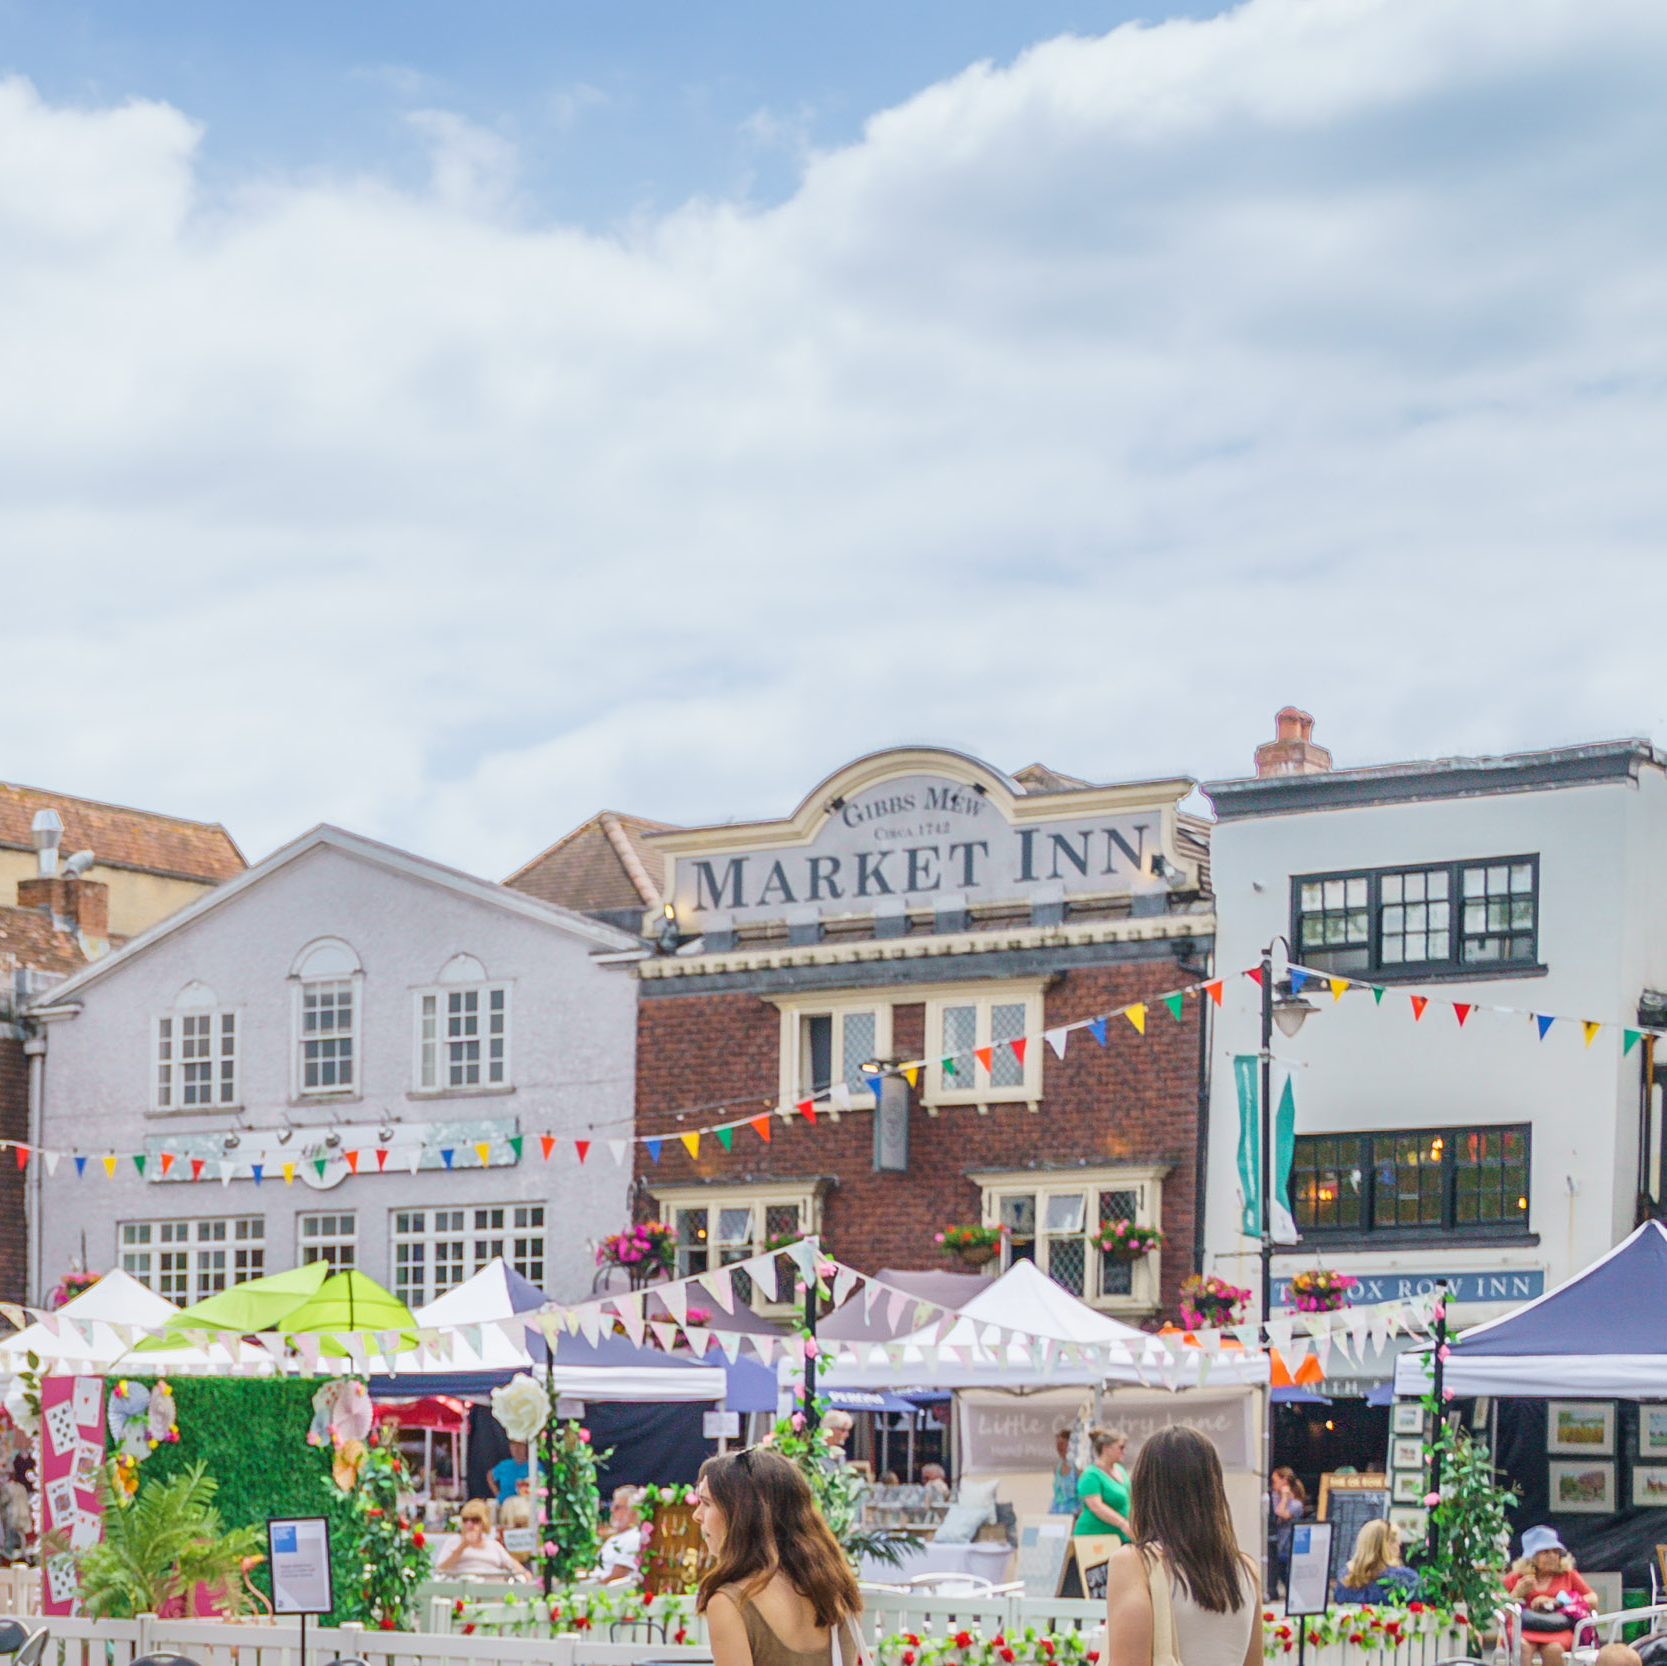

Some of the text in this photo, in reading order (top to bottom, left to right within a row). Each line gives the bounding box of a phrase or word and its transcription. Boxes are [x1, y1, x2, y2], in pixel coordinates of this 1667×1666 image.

[692, 824, 1150, 912] MARKET INN
[1347, 1279, 1386, 1300] OX
[1476, 1276, 1531, 1297] INN
[978, 1413, 1043, 1436] Little
